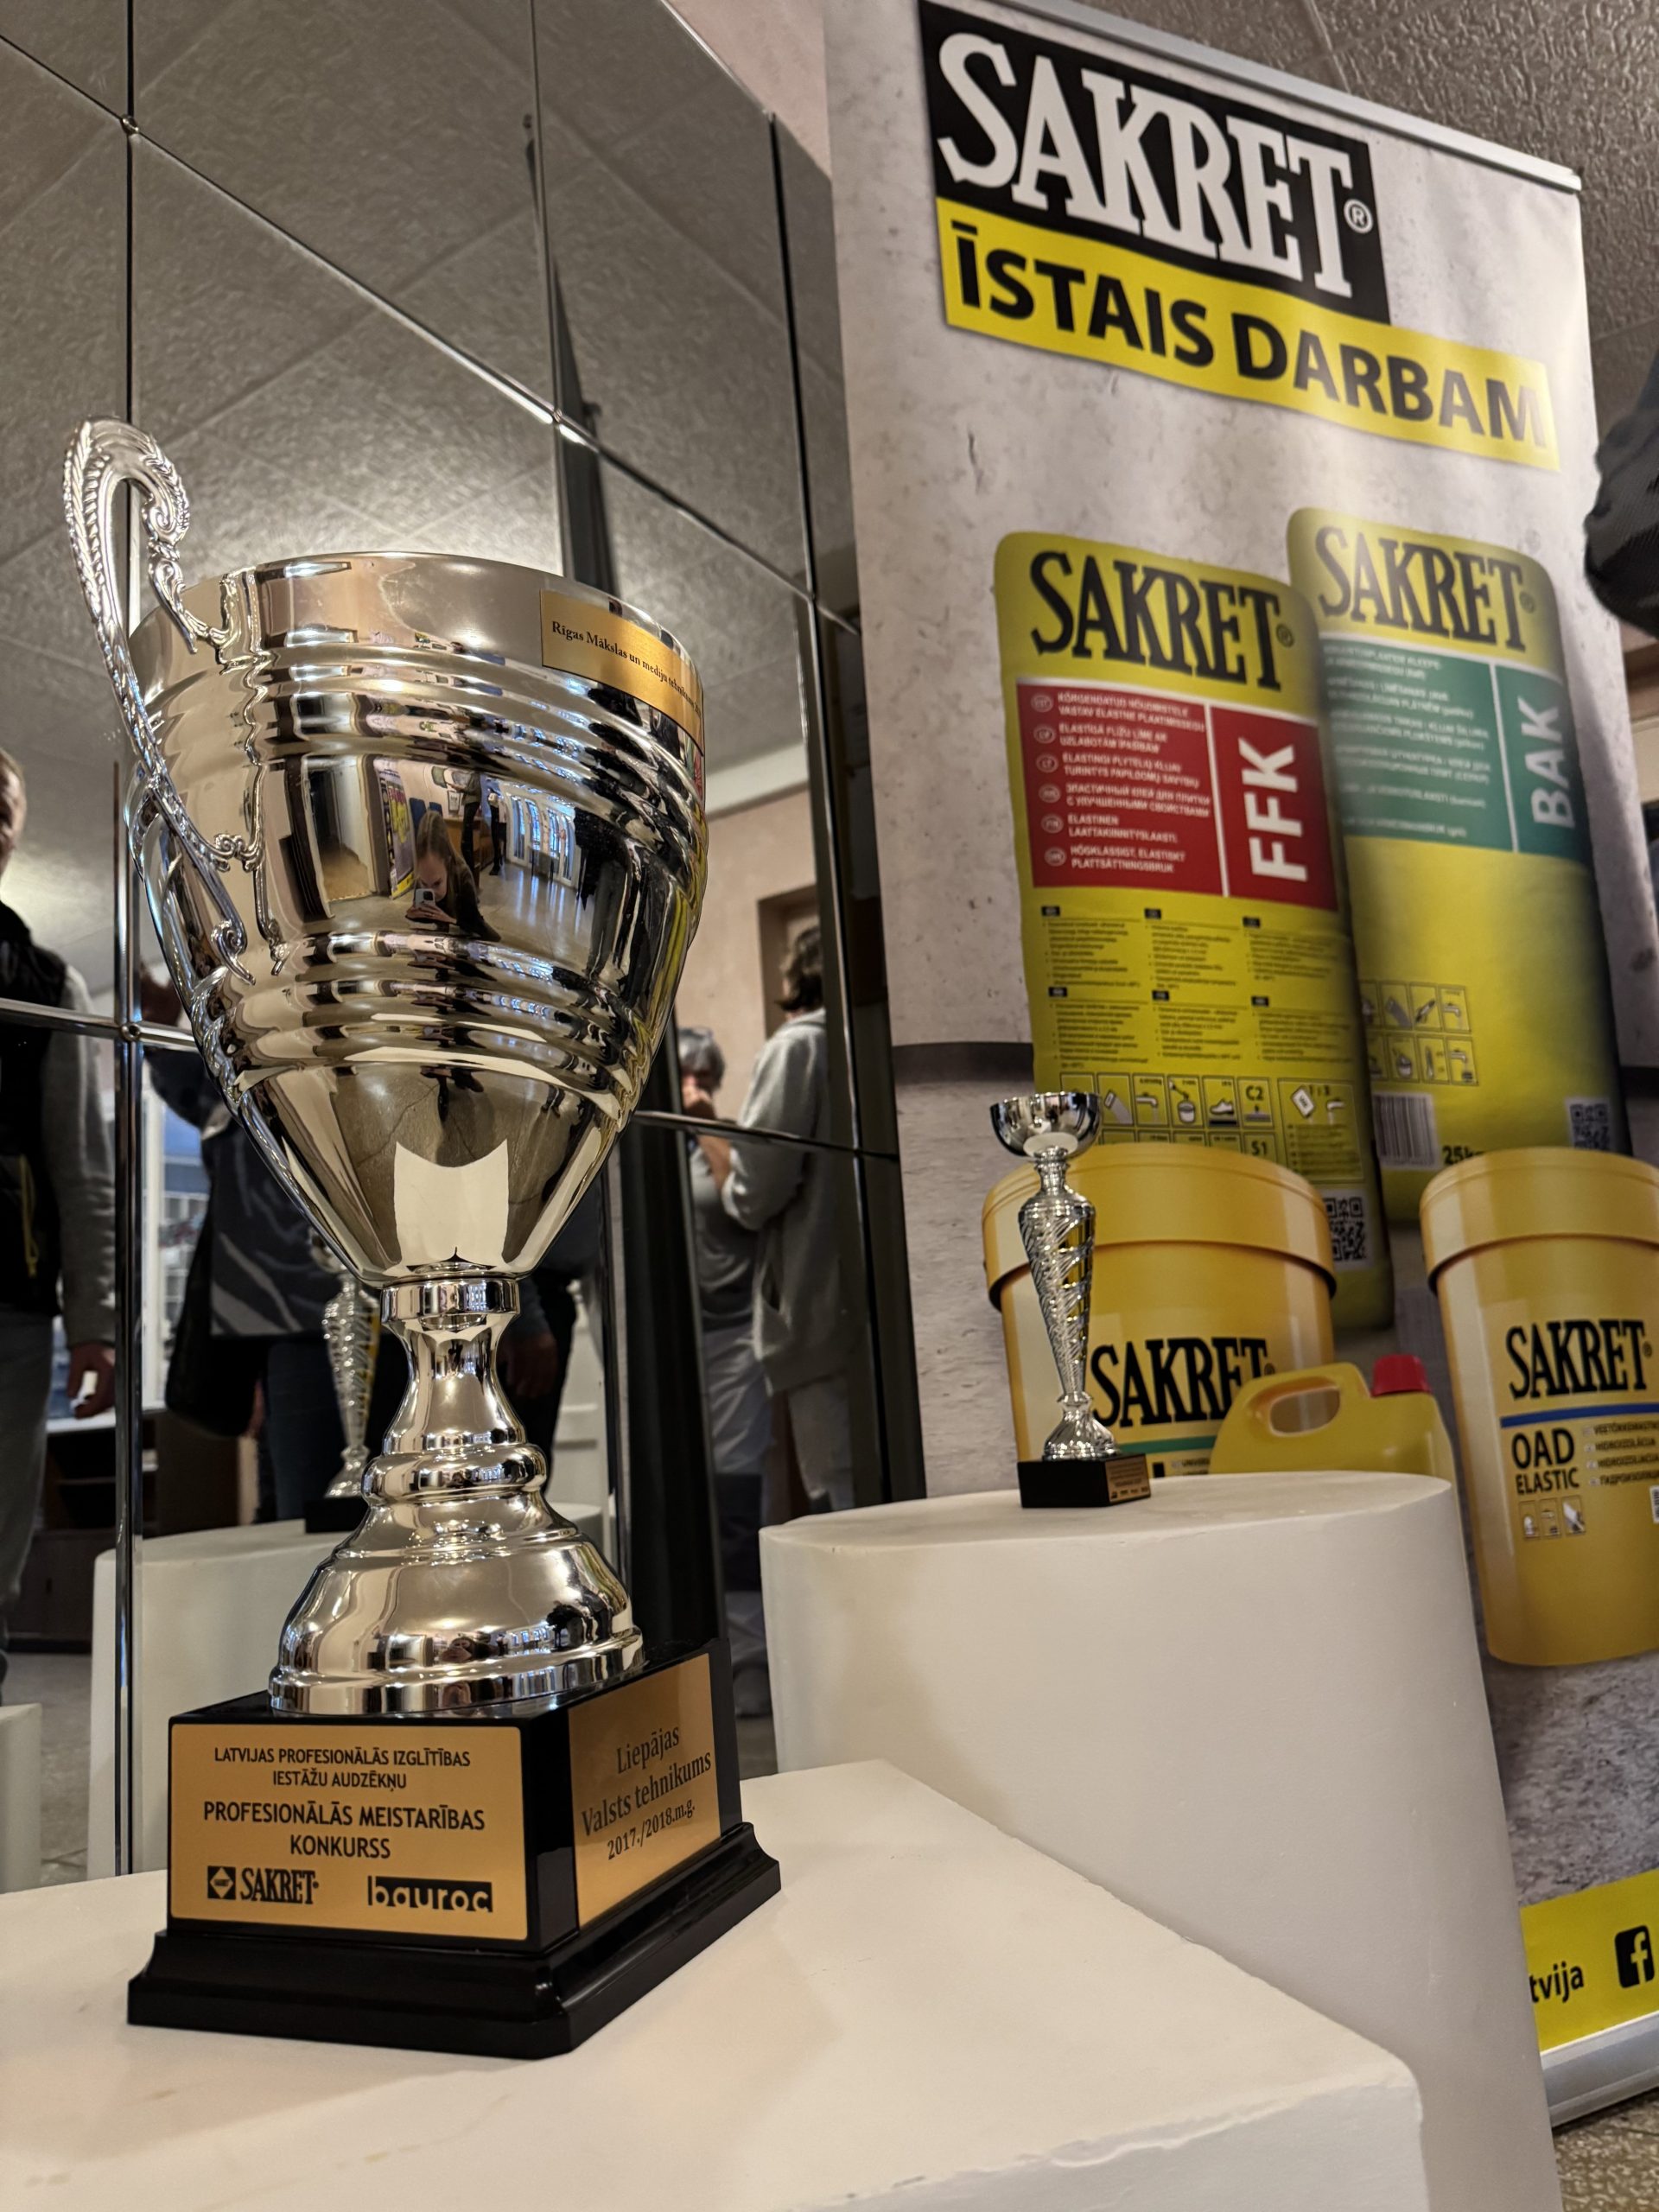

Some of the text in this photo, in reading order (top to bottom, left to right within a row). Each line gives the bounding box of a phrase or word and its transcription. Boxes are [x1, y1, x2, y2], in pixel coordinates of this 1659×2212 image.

[950, 220, 1548, 448] ĪSTAIS DARBAM
[629, 654, 641, 665] un
[642, 659, 668, 683] mediju
[1518, 696, 1576, 830] BAK
[1238, 737, 1308, 882] FFK
[1245, 1085, 1263, 1102] C2
[1251, 1141, 1267, 1156] S1
[1512, 1427, 1575, 1470] OAD
[1516, 1468, 1580, 1495] ELASTIC
[214, 1747, 471, 1767] LATVIJAS PROFESIONĀLĀS IZGLĪTĪBAS
[616, 1726, 680, 1775] Liepājas
[273, 1768, 407, 1792] IESTĀŽU AUDZĒKŅU
[581, 1751, 712, 1837] Valsts tehnikums
[204, 1801, 485, 1831] PROFESIONĀLĀS MEISTARĪBAS
[289, 1834, 391, 1859] KONKURSS
[367, 1876, 493, 1913] bauroc
